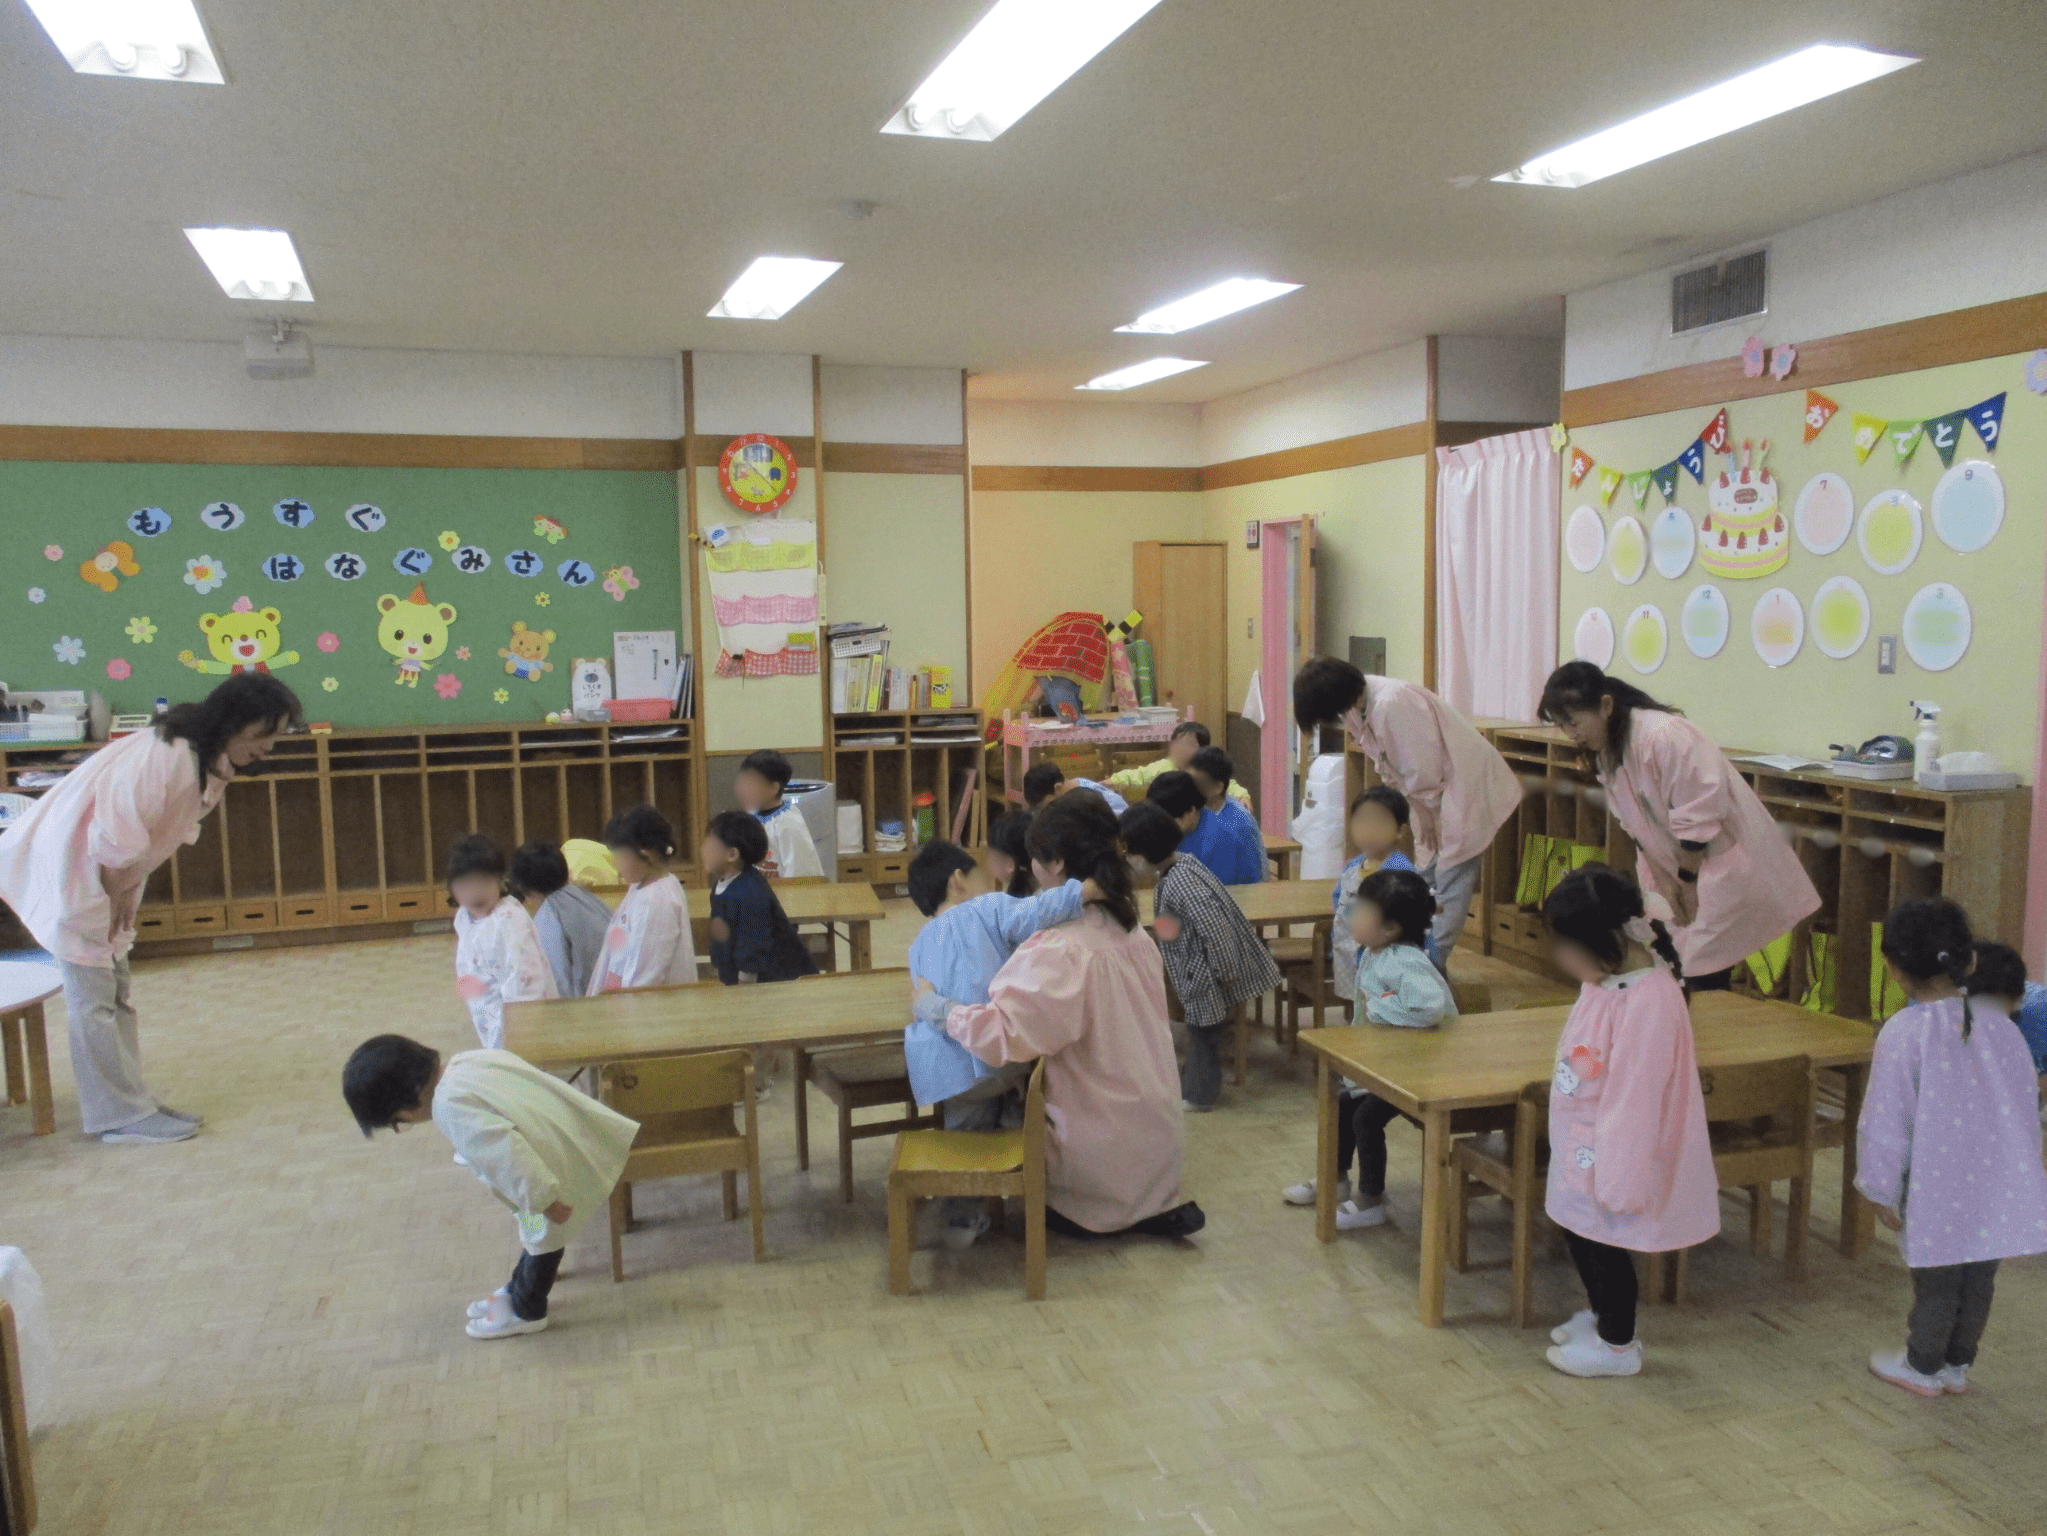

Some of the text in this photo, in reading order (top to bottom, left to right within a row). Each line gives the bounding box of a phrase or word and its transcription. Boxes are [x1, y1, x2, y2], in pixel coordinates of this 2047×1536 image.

[1806, 405, 1998, 454] おめでとう
[1819, 479, 1828, 490] 7
[1964, 469, 1974, 481] 9
[134, 500, 380, 535] もうすぐ
[271, 548, 587, 584] はなぐみさん
